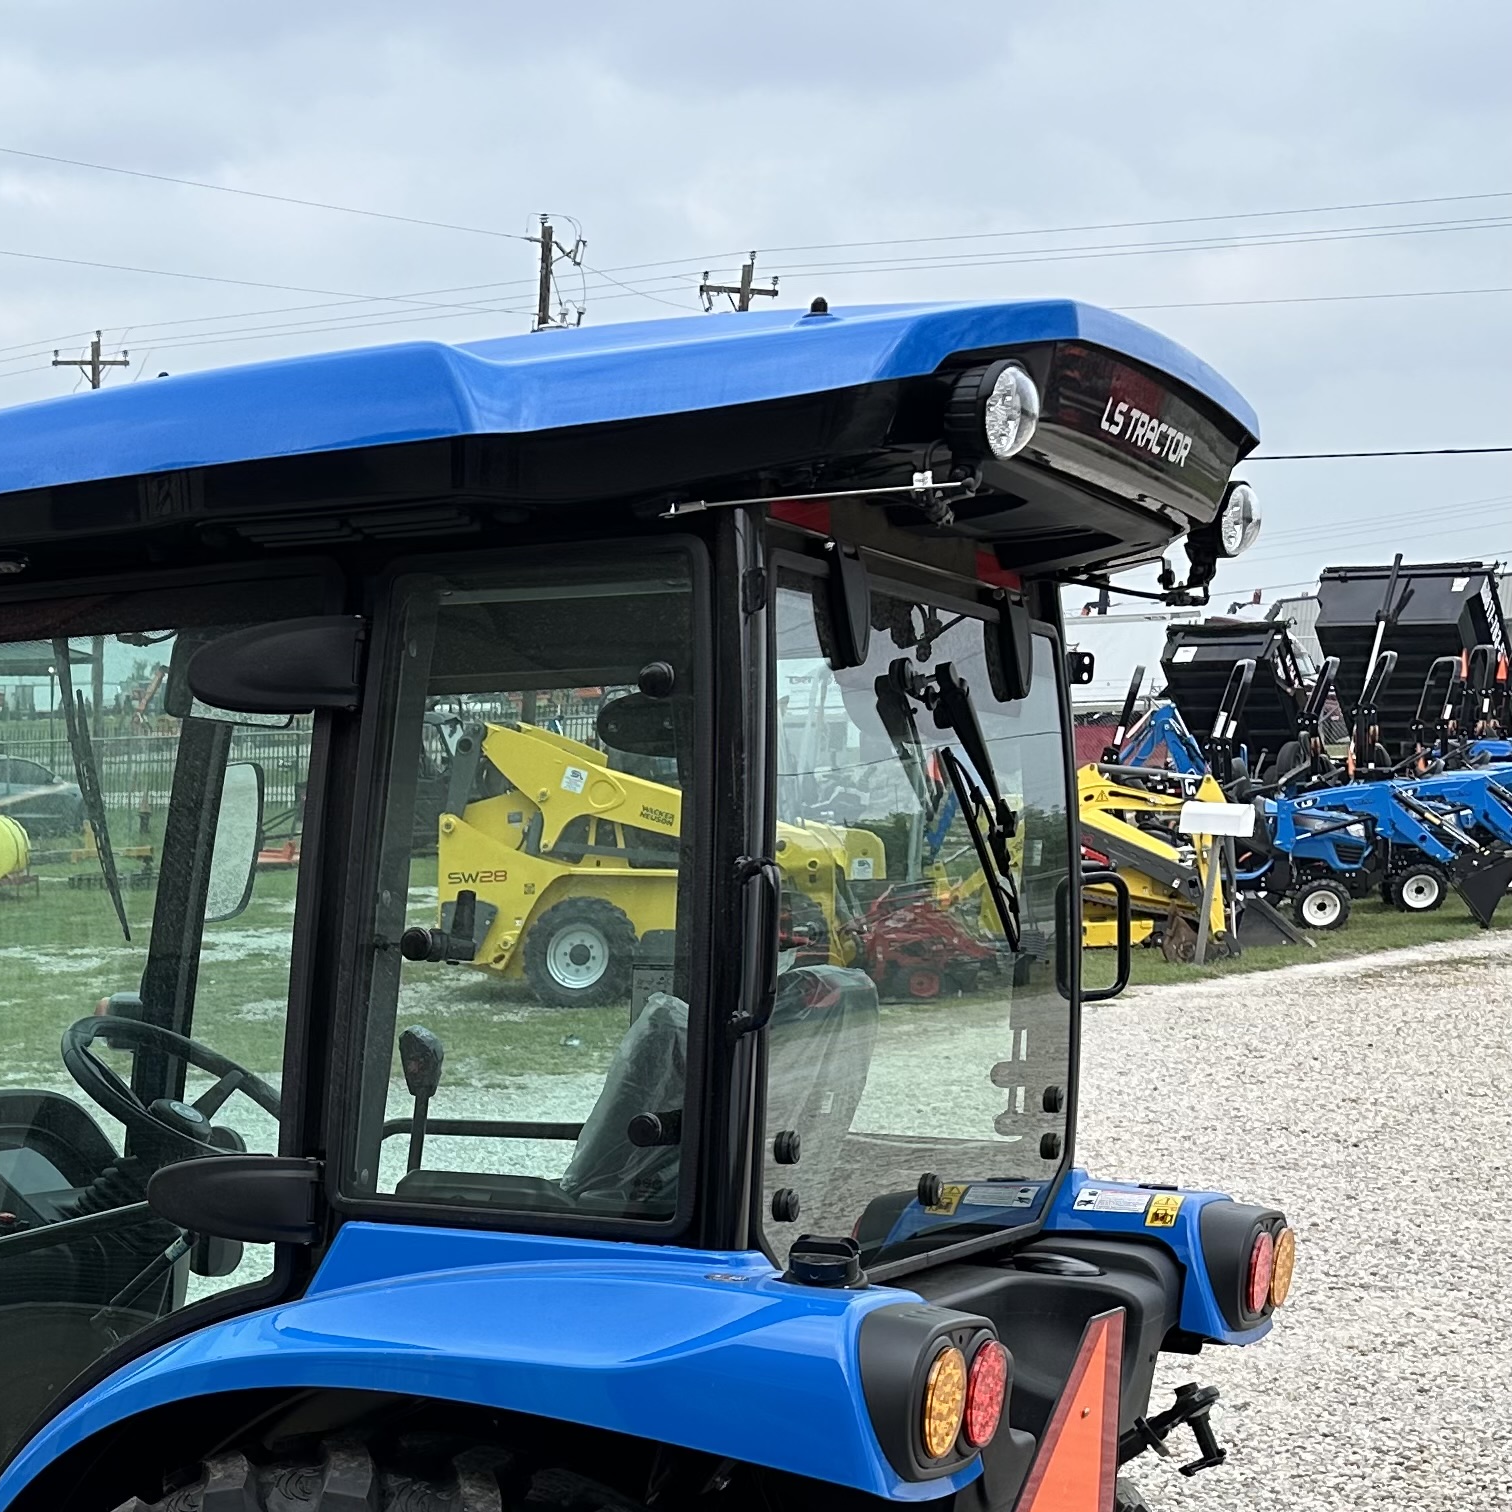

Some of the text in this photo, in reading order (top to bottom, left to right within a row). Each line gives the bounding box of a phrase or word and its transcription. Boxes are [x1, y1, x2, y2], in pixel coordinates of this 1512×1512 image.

[1100, 396, 1192, 468] LS TRACTOR
[639, 811, 674, 827] NEUSON
[641, 804, 675, 821] WACKER
[447, 869, 508, 885] SW28
